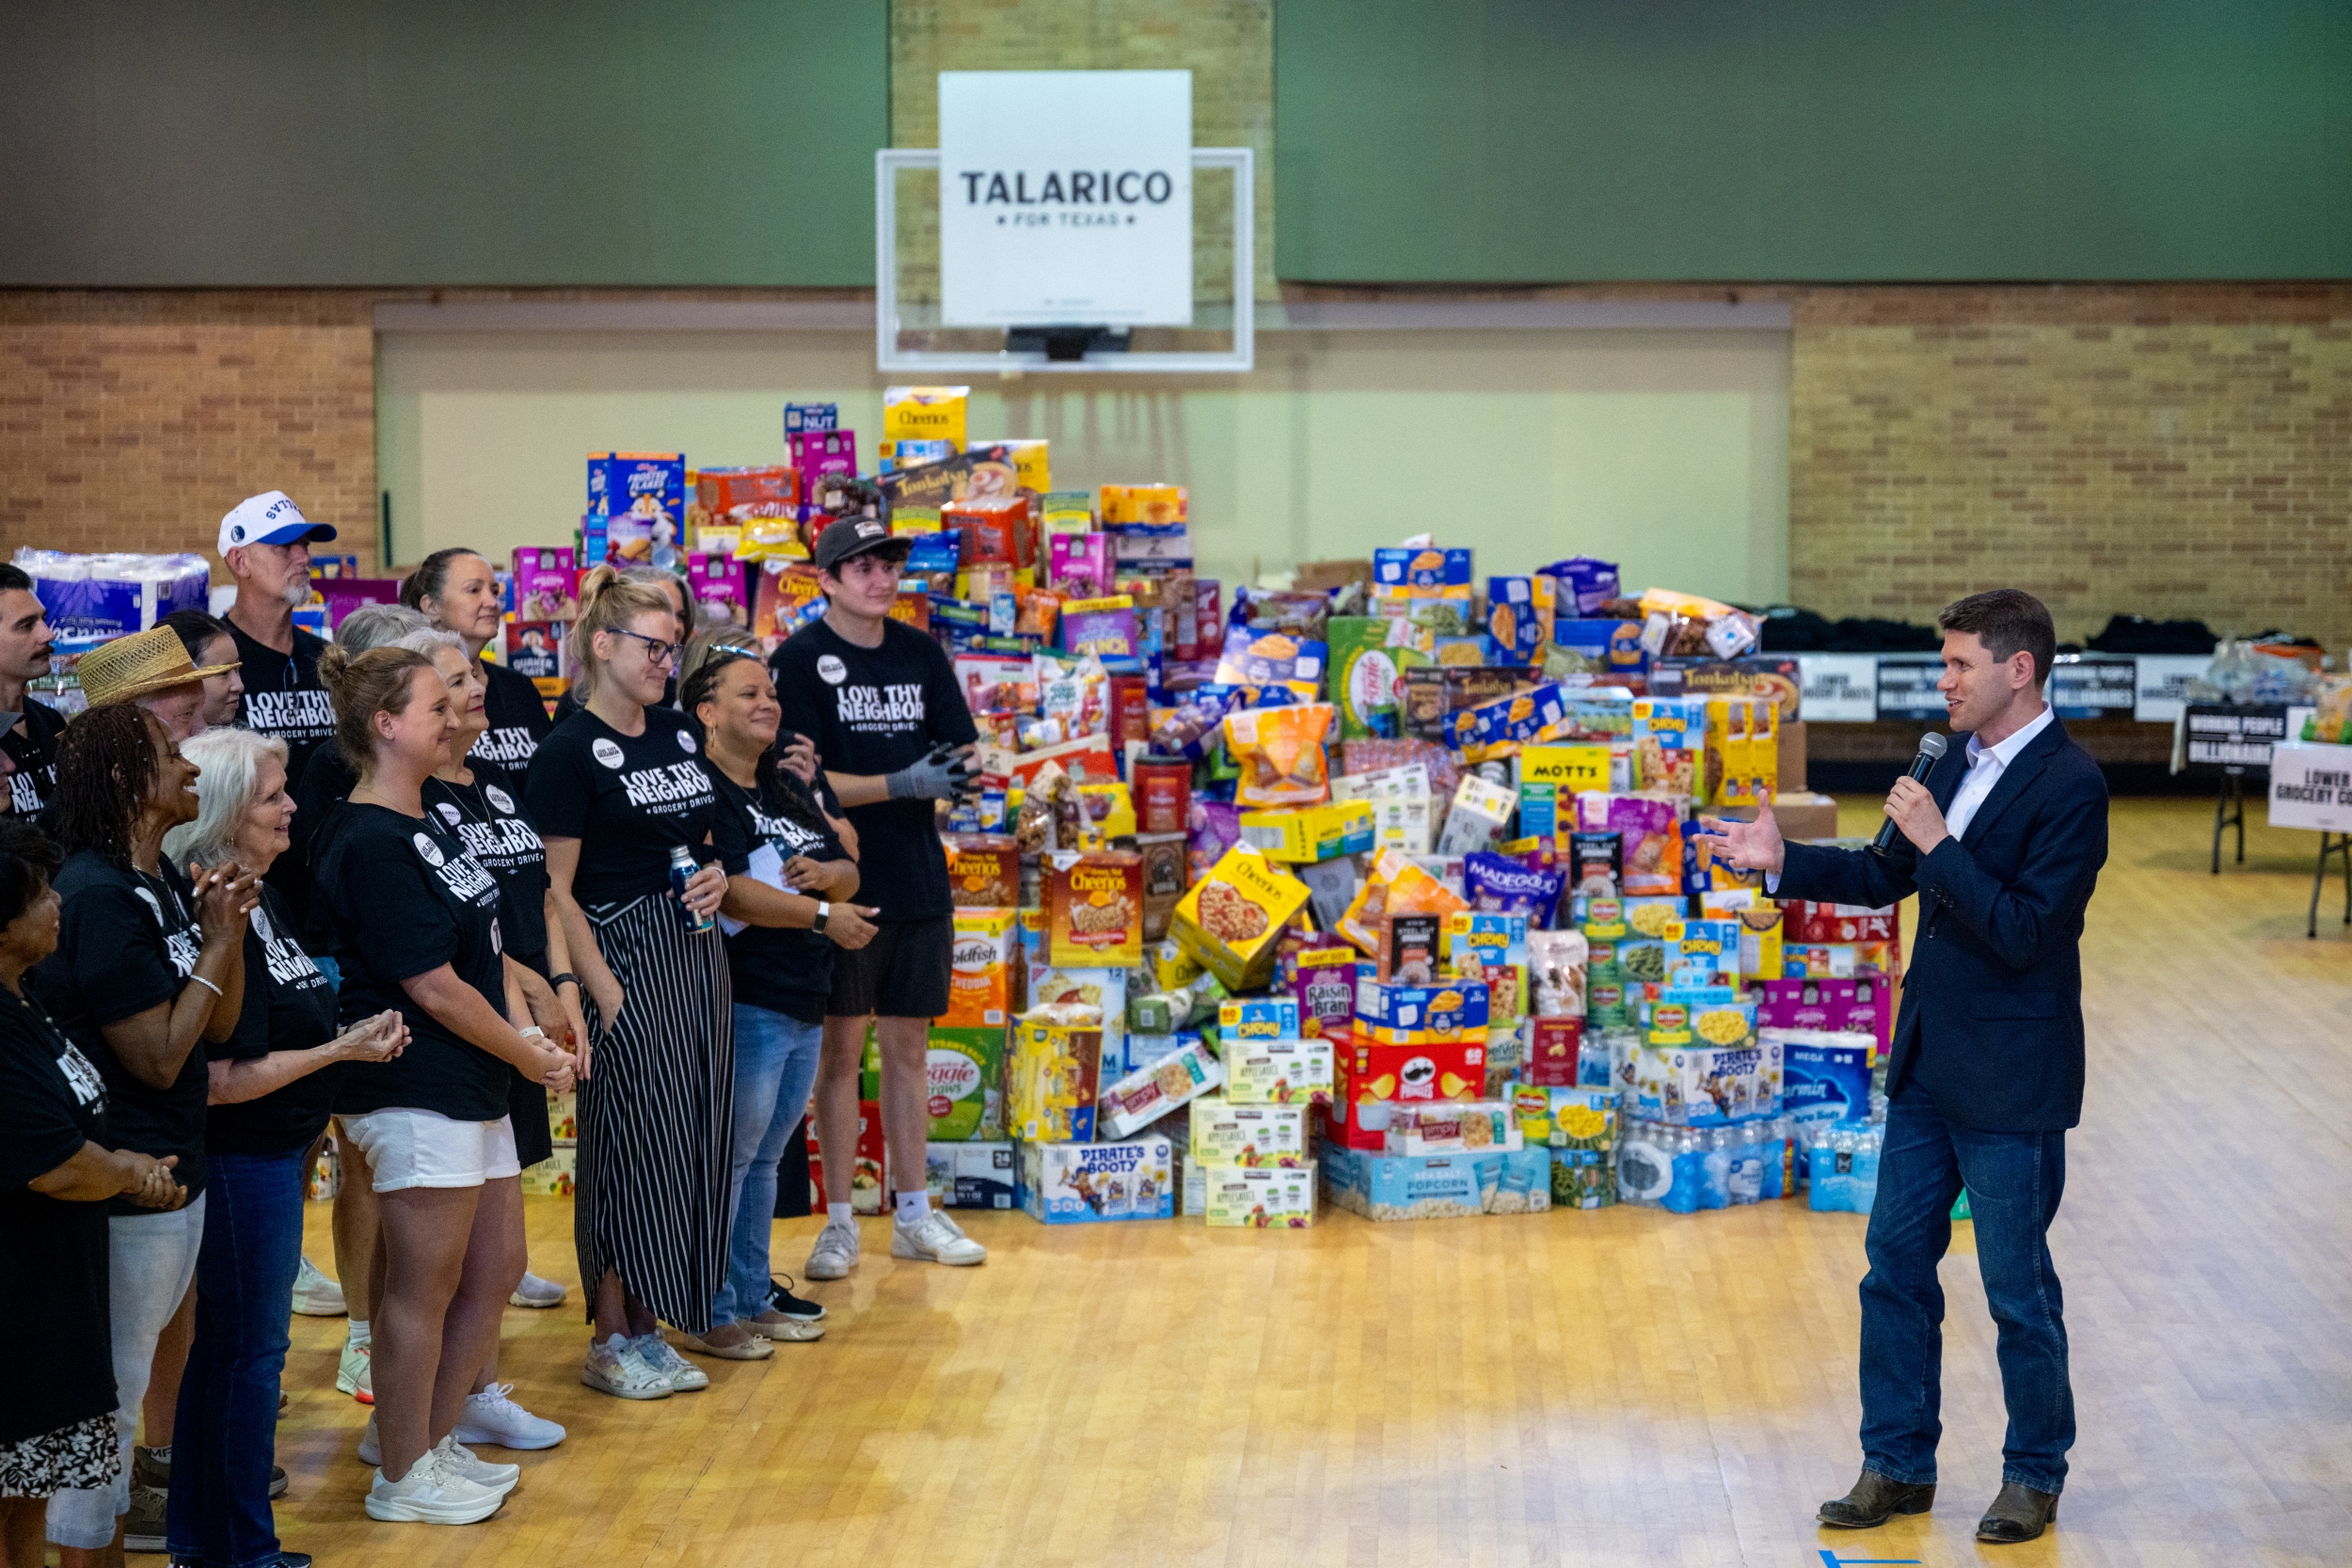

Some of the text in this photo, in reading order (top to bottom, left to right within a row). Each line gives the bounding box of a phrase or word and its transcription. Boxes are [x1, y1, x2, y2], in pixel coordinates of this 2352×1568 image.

[960, 170, 1173, 205] TALARICO
[1013, 213, 1120, 227] FOR TEXAS
[898, 410, 950, 425] Cheerios
[513, 657, 554, 670] QUAKER
[245, 689, 332, 712] LOVE THY
[837, 683, 922, 705] LOVE THY
[246, 707, 338, 729] NEIGHBOR
[836, 701, 926, 722] NEIGHBOR
[269, 727, 333, 739] GROCERY DRIVE
[493, 726, 532, 745] THY
[855, 721, 915, 732] GROCERY DRVE
[2243, 716, 2284, 736] PEOPLE
[508, 760, 529, 771] DRIV
[618, 759, 704, 790] LOVE THY
[1533, 764, 1598, 779] MOTT'S
[2305, 768, 2351, 787] LOWER
[626, 774, 713, 807] NEIGHBOR
[2277, 783, 2332, 804] GROCERY
[652, 794, 712, 815] GROCERY DRIVE
[457, 817, 530, 840] OVE THY
[483, 852, 540, 868] GROCERY DRIVE
[436, 856, 472, 887] LOVE
[1235, 860, 1283, 901] Cheerios
[1468, 861, 1558, 895] MADEGOOD
[449, 868, 497, 903] NEIGHBO
[1070, 874, 1127, 892] Cheerios
[264, 938, 290, 966] LOV
[952, 945, 997, 964] oldfish
[1108, 967, 1123, 978] 12
[1308, 984, 1351, 1003] Raisin
[1314, 1001, 1349, 1016] Bran
[1465, 1047, 1484, 1059] 60
[1794, 1052, 1825, 1063] MEGA
[926, 1067, 975, 1085] eggie
[994, 1152, 1011, 1164] 24
[1080, 1146, 1145, 1163] PIRATE'S
[1086, 1160, 1138, 1175] BOOTY
[1406, 1179, 1469, 1191] POPCORN
